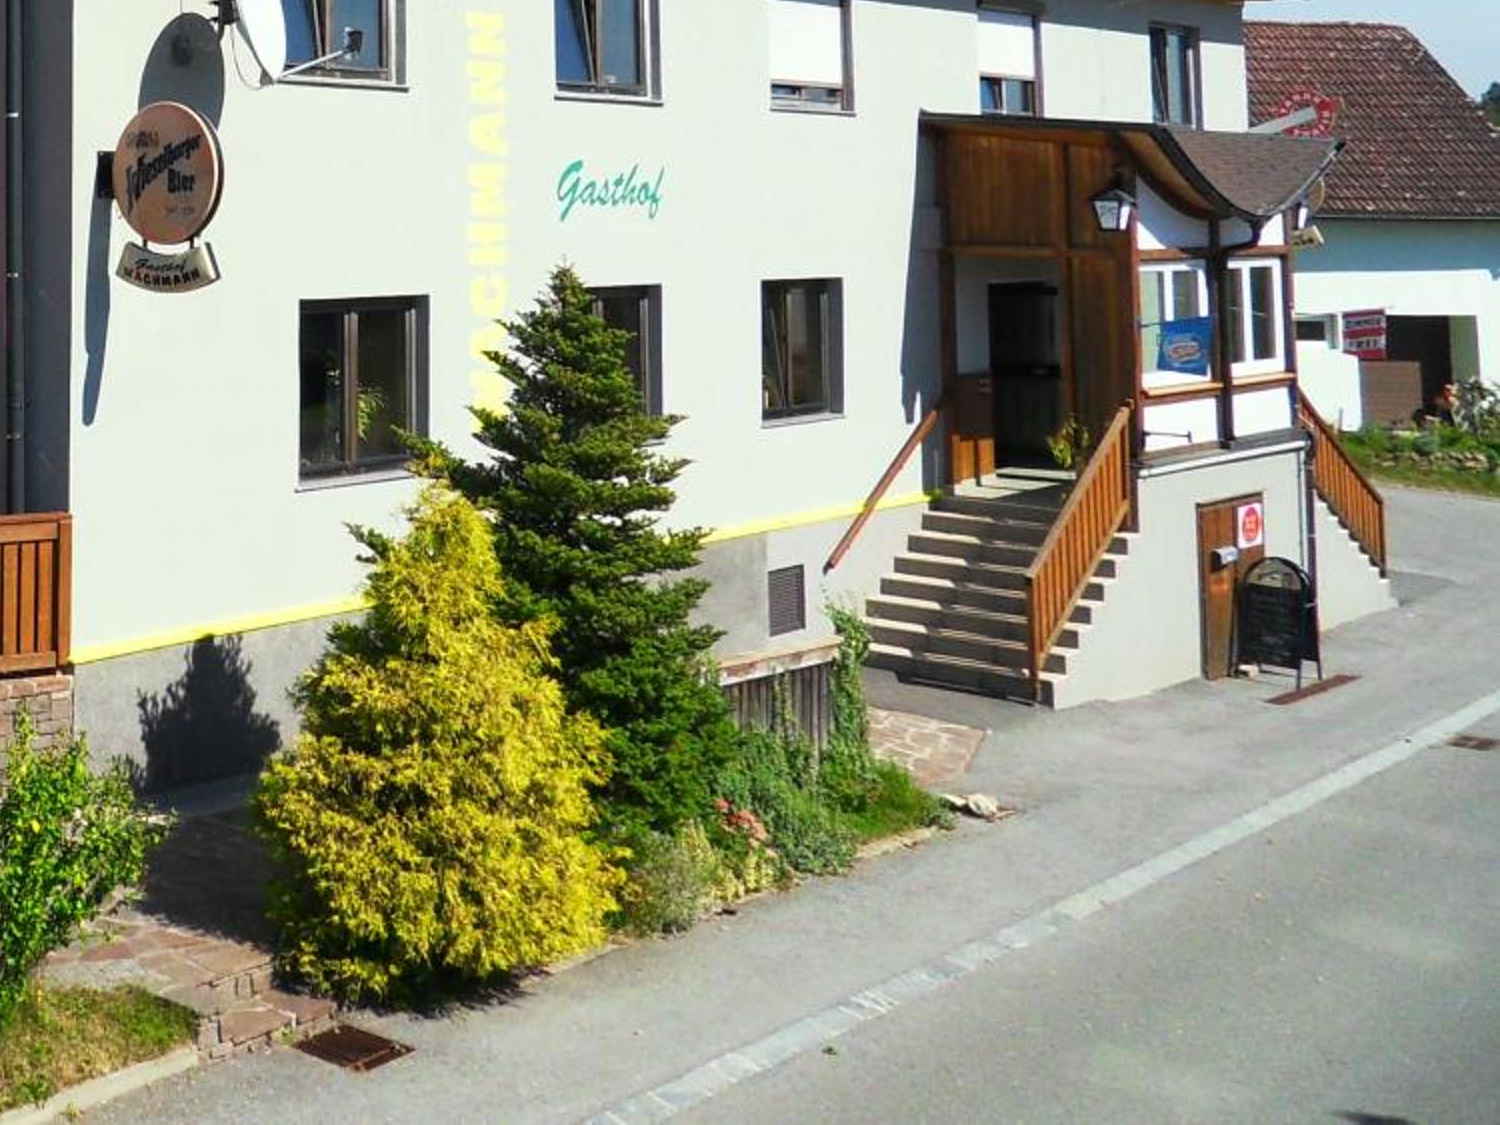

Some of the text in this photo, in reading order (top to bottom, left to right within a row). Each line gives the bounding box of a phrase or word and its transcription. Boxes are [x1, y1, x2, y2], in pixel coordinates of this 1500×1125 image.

[167, 168, 196, 193] Bier
[557, 159, 665, 221] Gasthof
[123, 266, 200, 287] WACHMANN
